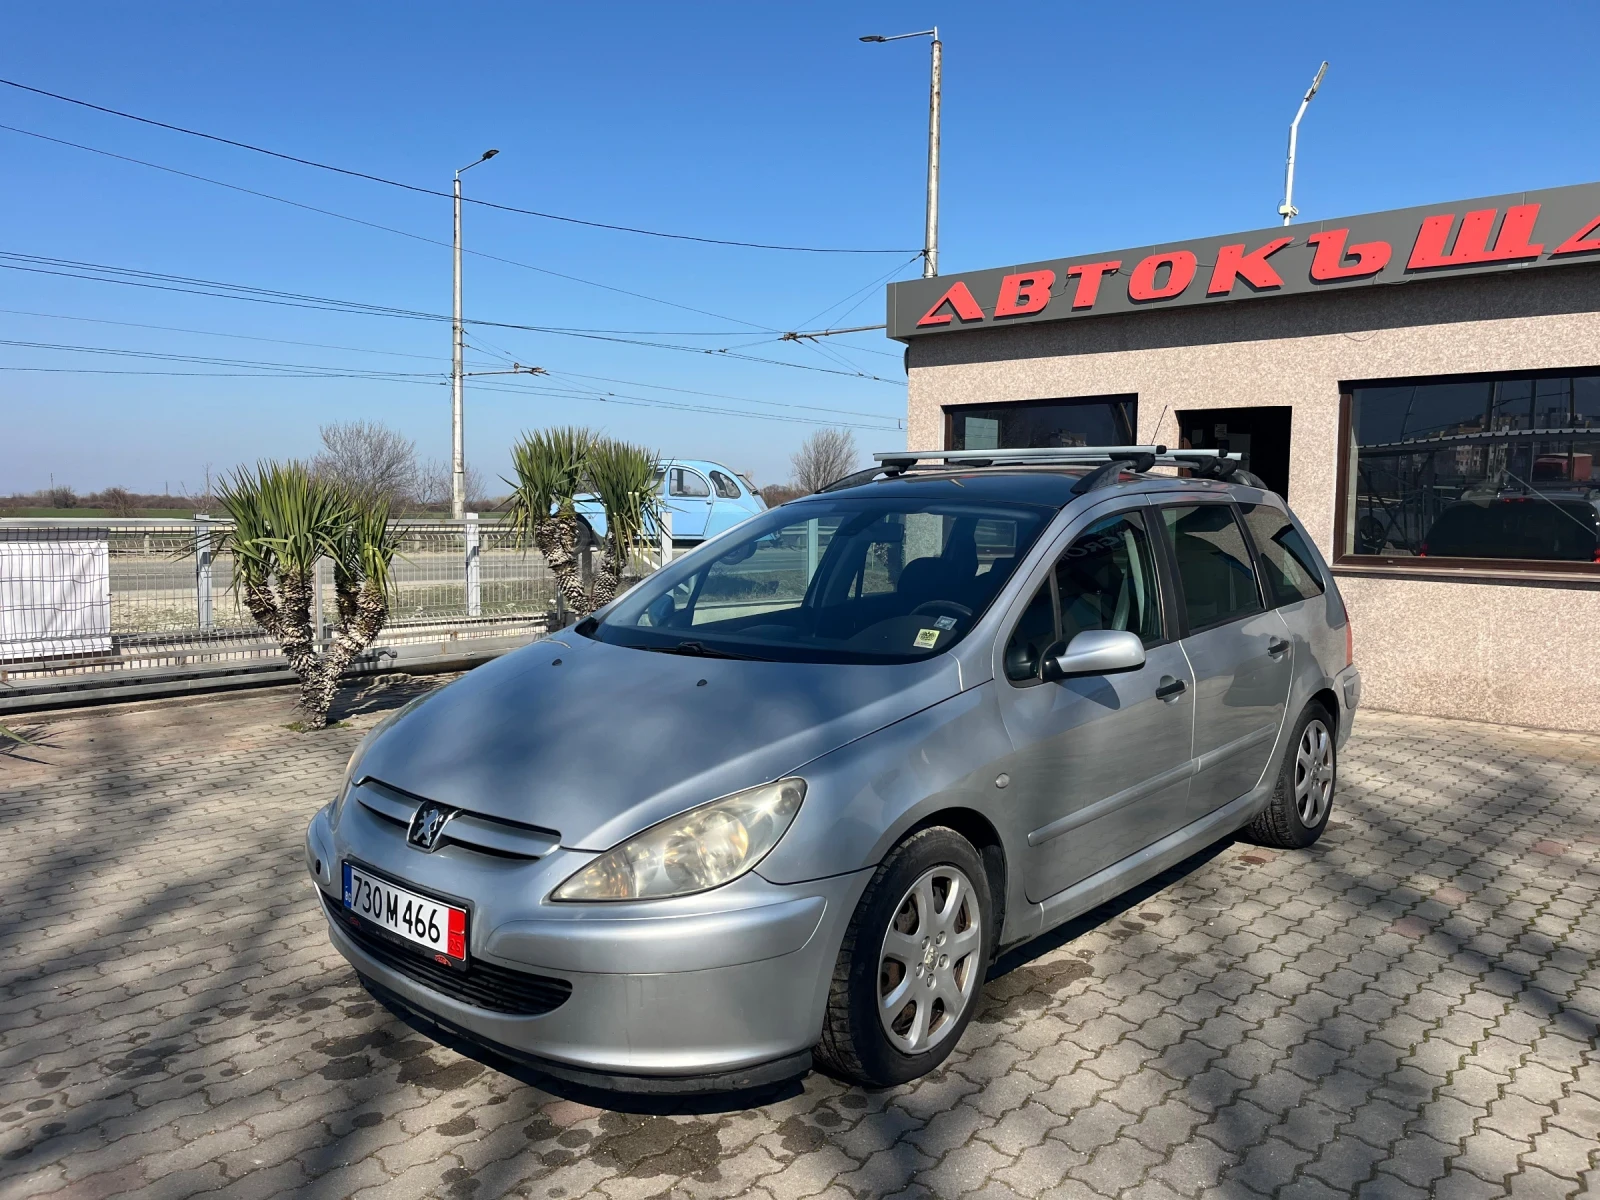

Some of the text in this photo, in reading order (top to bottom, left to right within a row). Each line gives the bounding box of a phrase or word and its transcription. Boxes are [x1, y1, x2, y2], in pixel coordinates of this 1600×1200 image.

[353, 874, 383, 919] 730
[386, 890, 399, 928] M
[402, 899, 441, 944] 466
